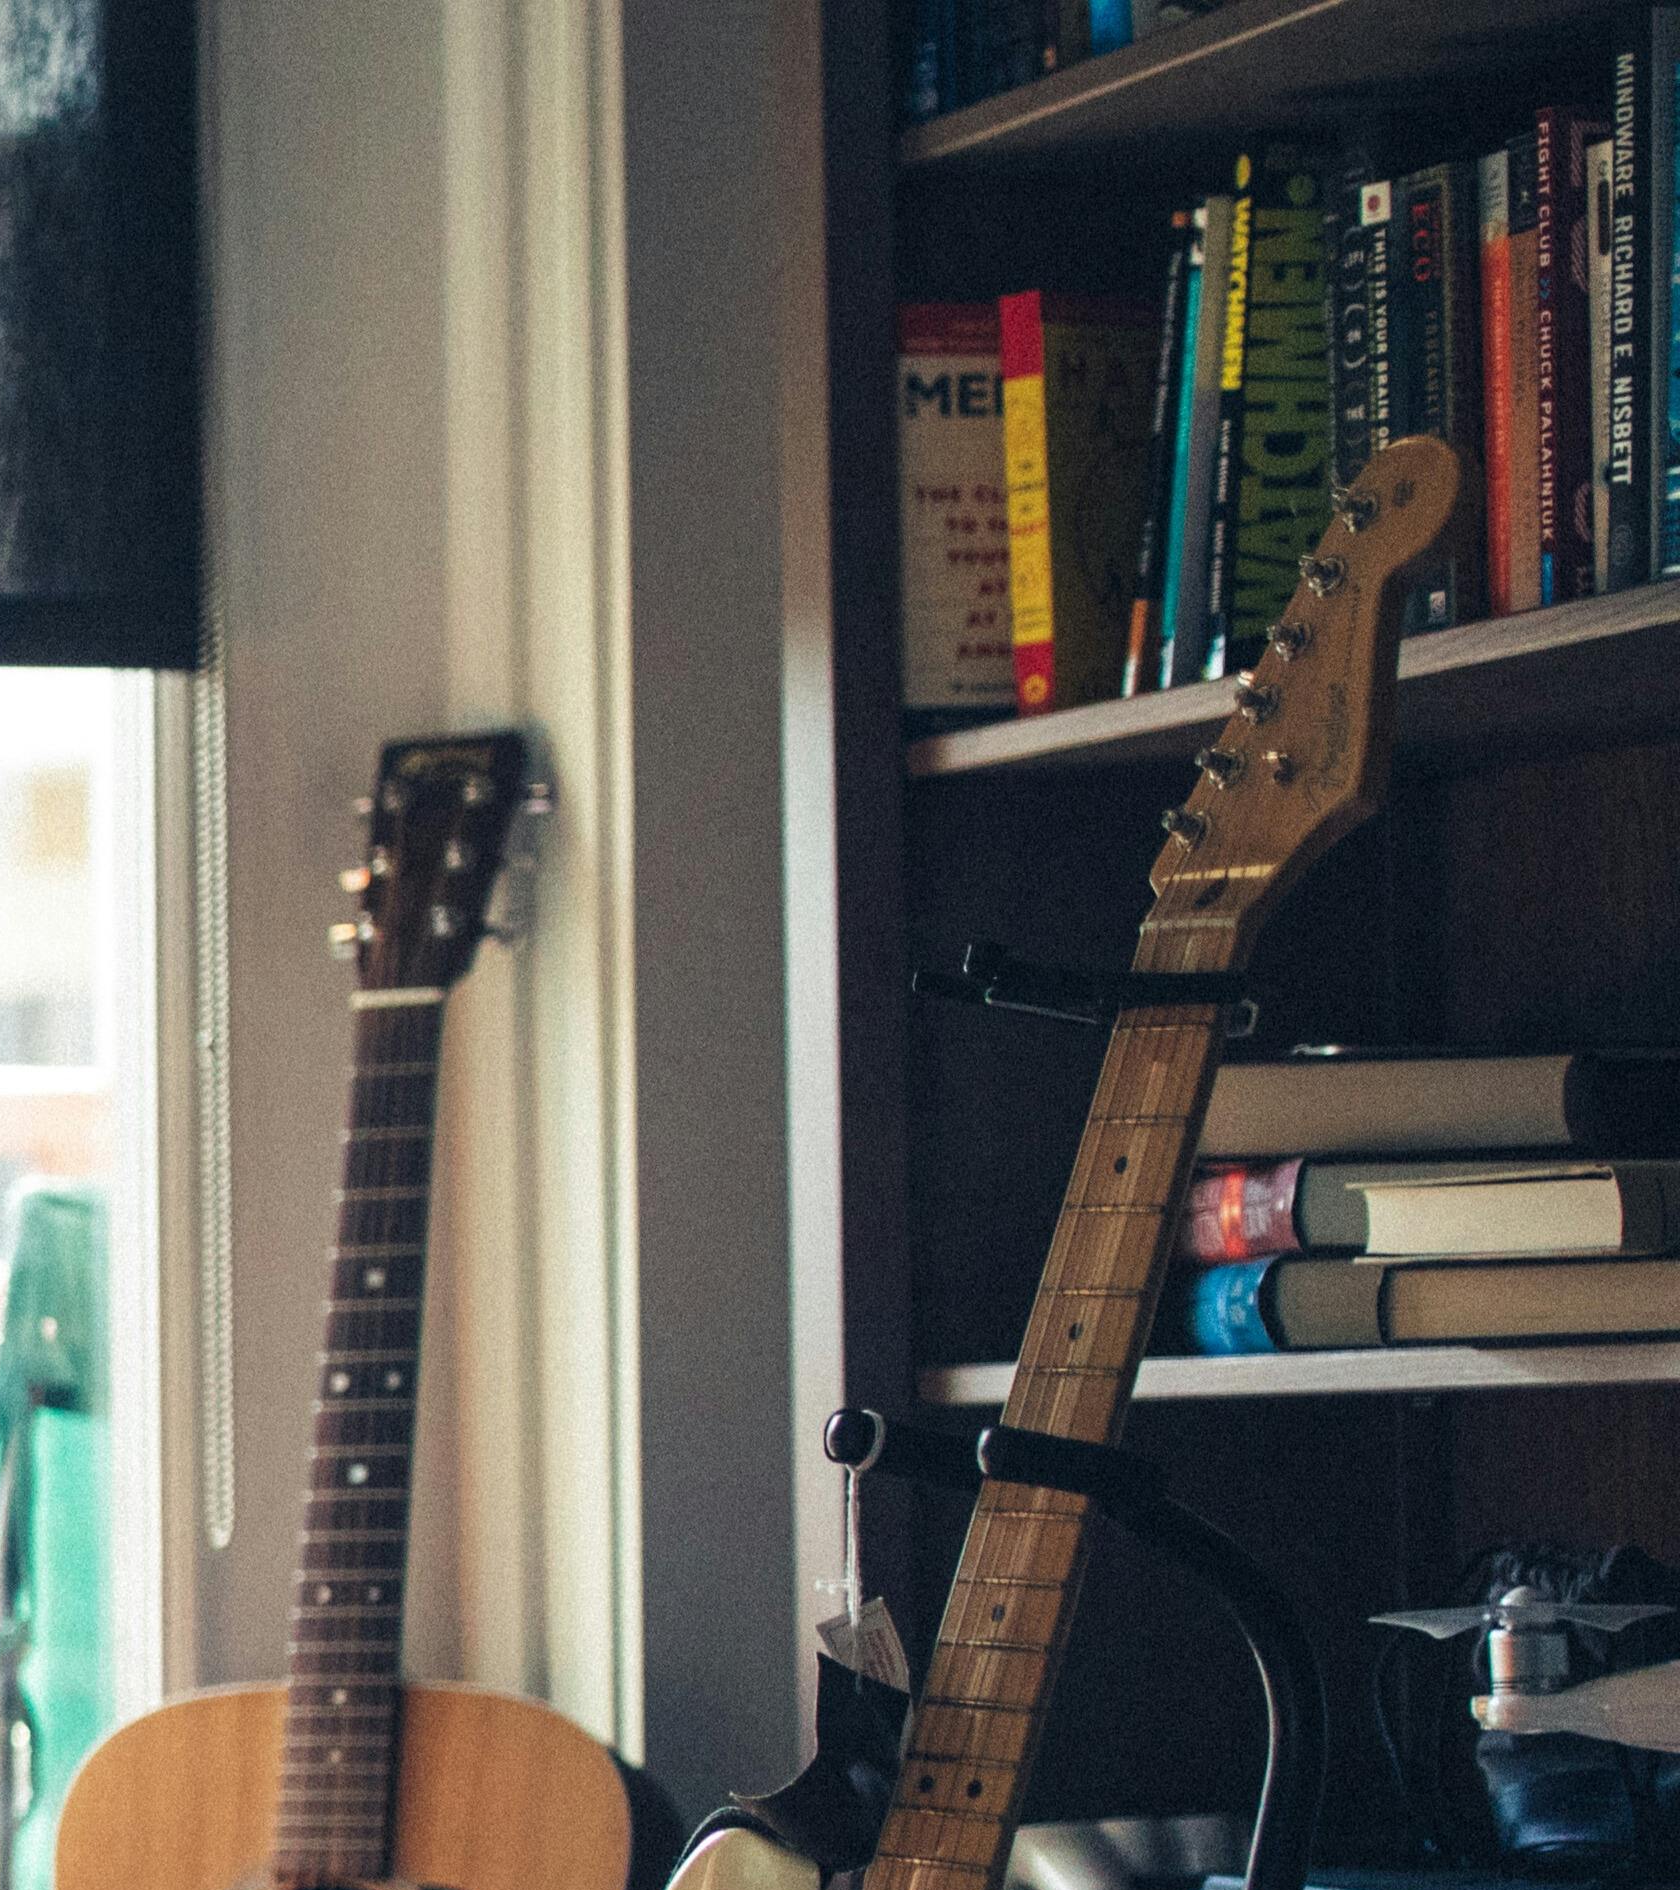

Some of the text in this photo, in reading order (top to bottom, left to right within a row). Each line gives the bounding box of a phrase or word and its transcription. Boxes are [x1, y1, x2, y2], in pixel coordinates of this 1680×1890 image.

[1372, 228, 1387, 273] THIS
[1410, 200, 1432, 283] ECO
[1611, 54, 1635, 486] MINDWARE RICHARD E. NISBETT
[1220, 197, 1253, 391] WATCHMEN
[1373, 279, 1387, 300] IS
[1374, 303, 1388, 354] YOUR
[1536, 120, 1554, 542] FIGHT CLUB CHUCK PALAHNIUK
[1375, 360, 1389, 418] BRAIN
